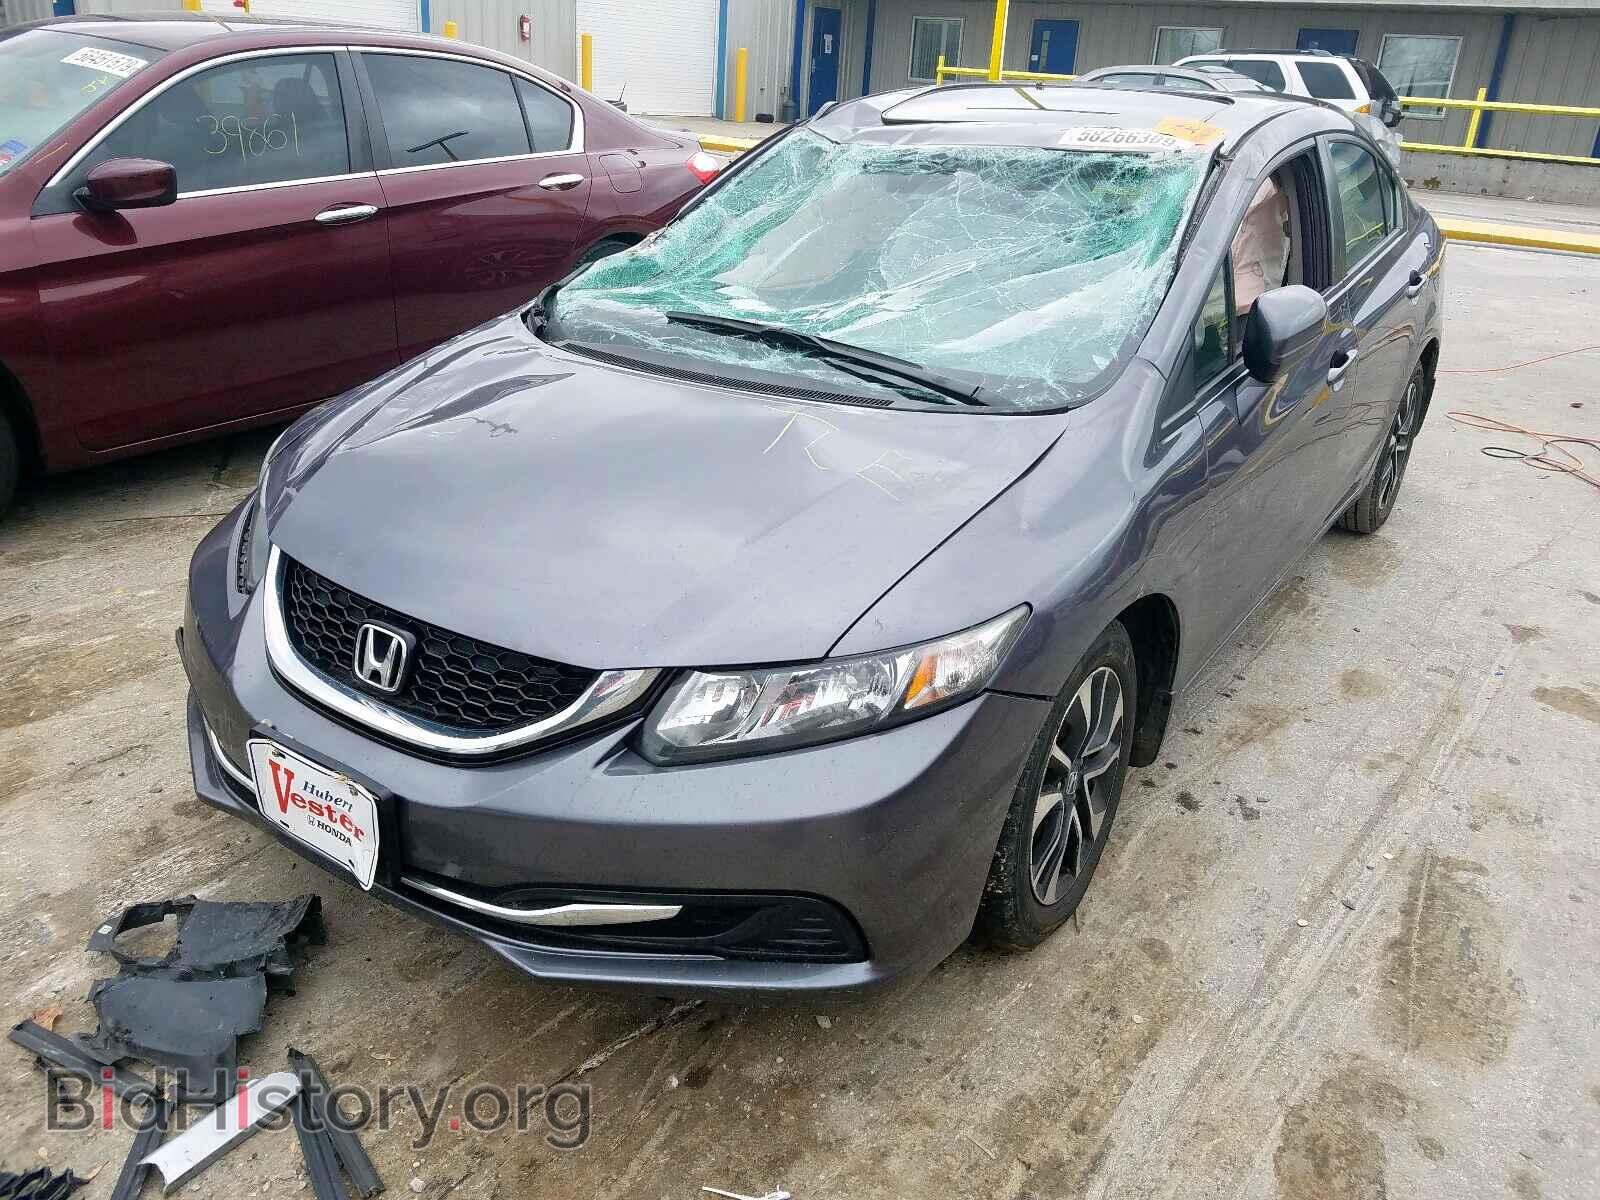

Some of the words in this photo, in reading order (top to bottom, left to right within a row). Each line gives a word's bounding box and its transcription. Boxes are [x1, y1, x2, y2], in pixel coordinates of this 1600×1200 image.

[195, 111, 303, 161] 39861
[268, 758, 366, 842] Vester
[302, 781, 354, 813] Hubert
[316, 821, 353, 847] HONDA
